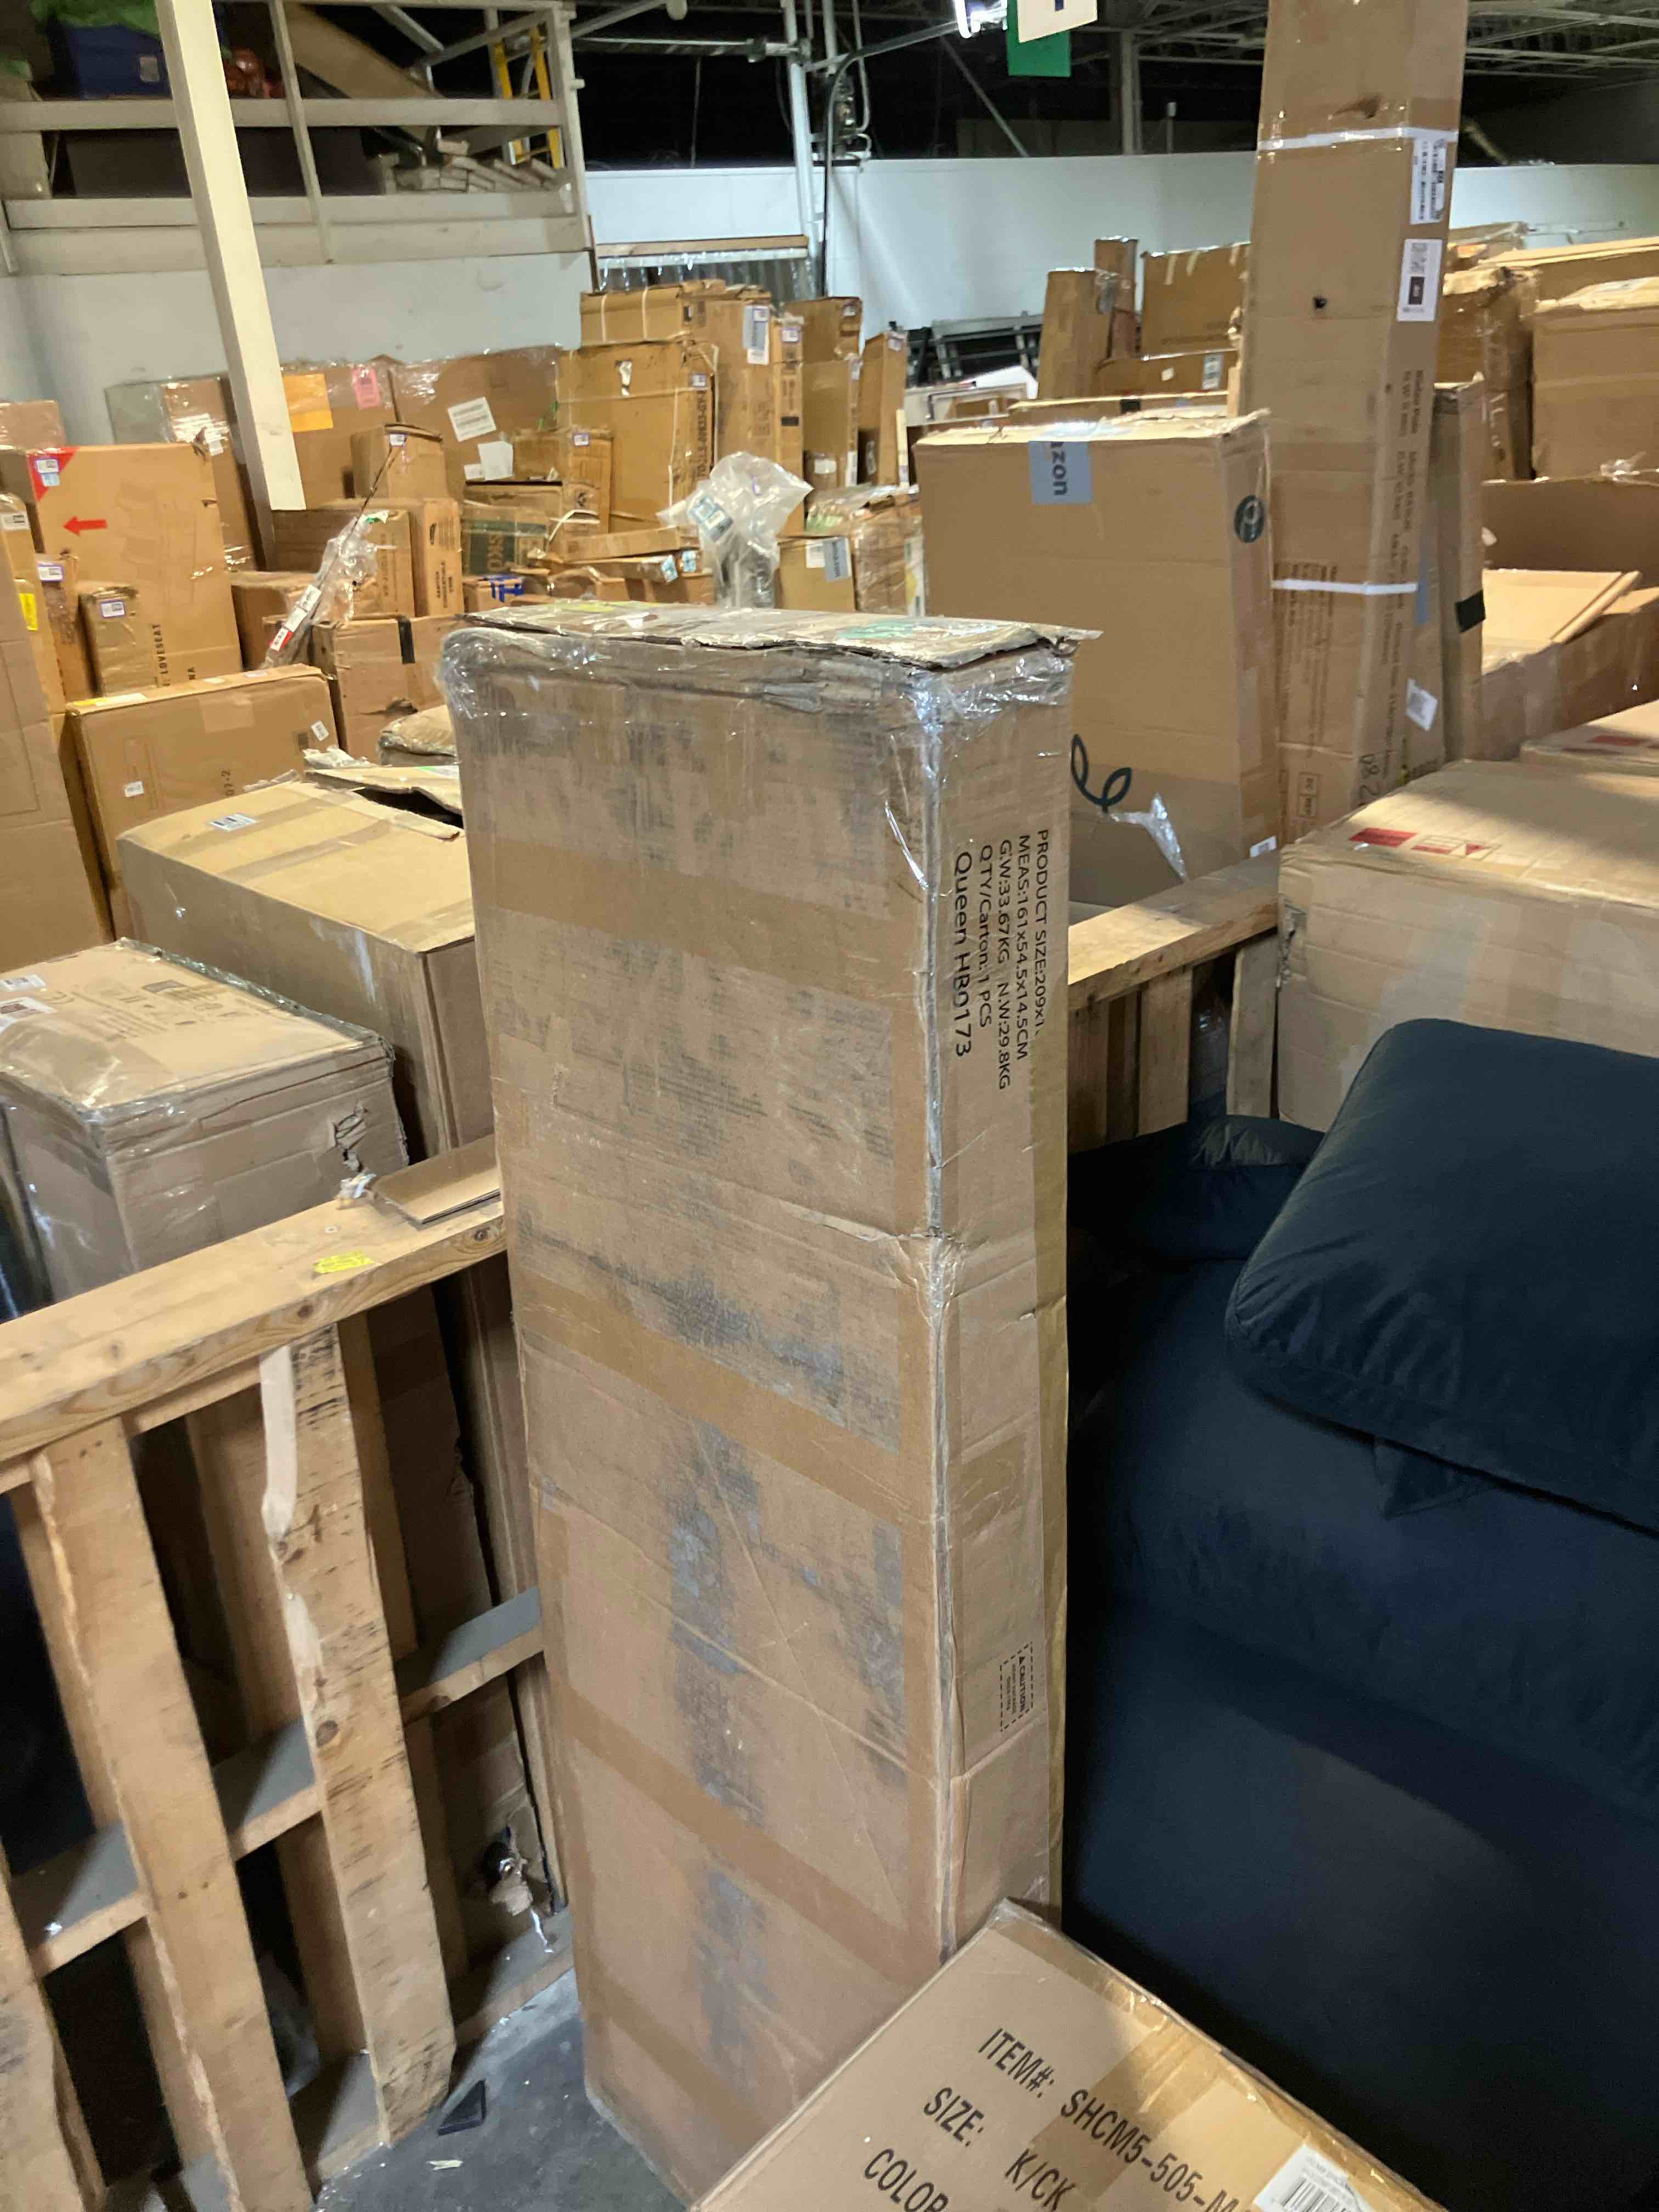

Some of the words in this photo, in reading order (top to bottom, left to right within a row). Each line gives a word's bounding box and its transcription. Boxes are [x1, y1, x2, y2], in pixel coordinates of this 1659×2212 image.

[152, 624, 168, 674] LOVESEAT
[954, 851, 973, 945] Queen
[978, 844, 993, 971] QTY/Carton:
[1035, 829, 1049, 924] PRODUCT
[978, 974, 990, 984] 1
[1017, 834, 1031, 1060] MEAS:161x54.5x14.5CM
[1035, 930, 1047, 1036] SIZE:209x1
[979, 990, 992, 1028] PCS
[997, 981, 1011, 1090] N.W:29.8KG
[923, 2087, 984, 2146] SIZE:
[1005, 2148, 1076, 2211] K/CK
[978, 2028, 1054, 2098] ITEM#:
[1060, 2089, 1249, 2212] SHCM5-505-M
